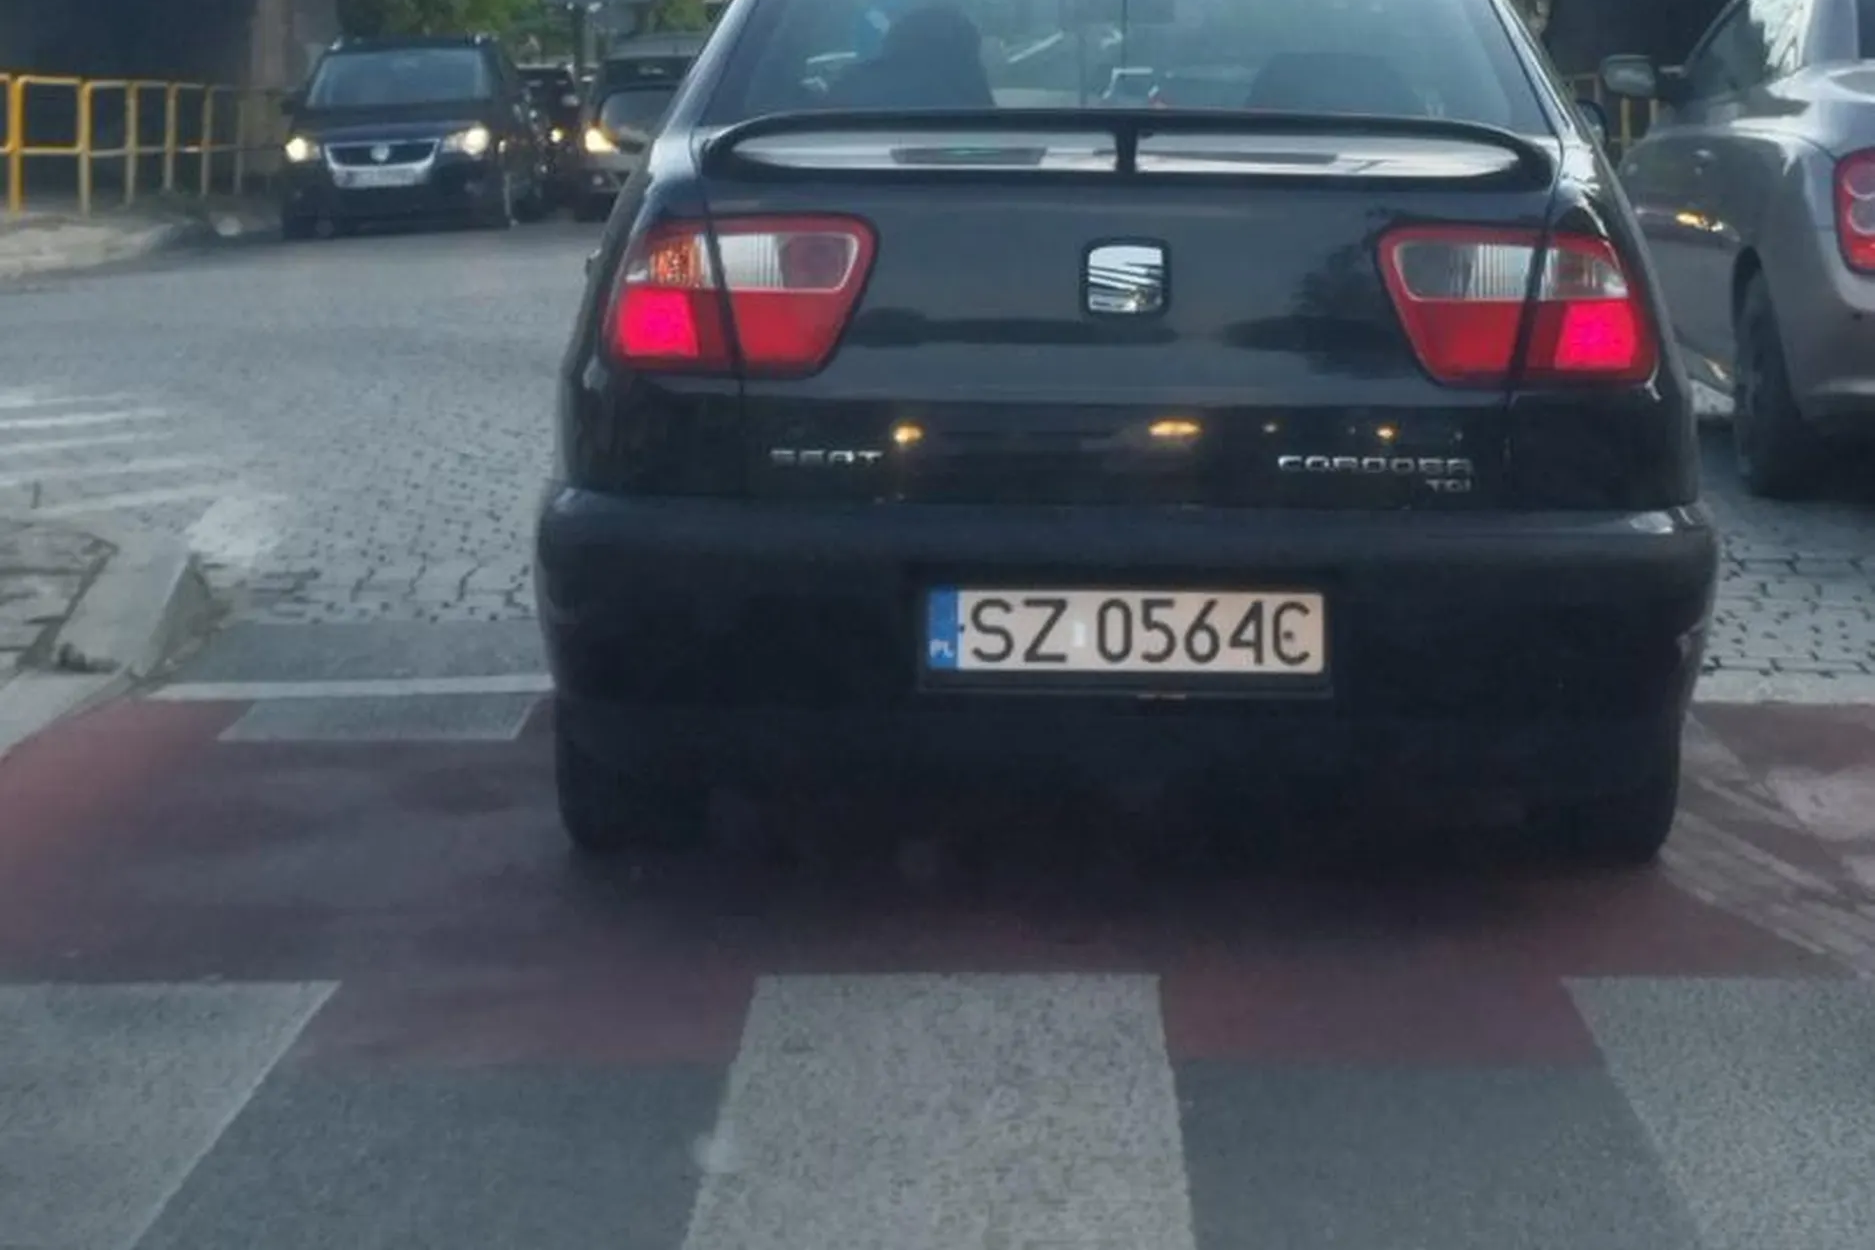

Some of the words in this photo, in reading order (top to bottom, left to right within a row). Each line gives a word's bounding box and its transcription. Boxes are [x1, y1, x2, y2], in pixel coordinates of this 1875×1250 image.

[929, 639, 954, 658] PL
[970, 597, 1068, 664] SZ
[1096, 598, 1312, 666] 0564C
